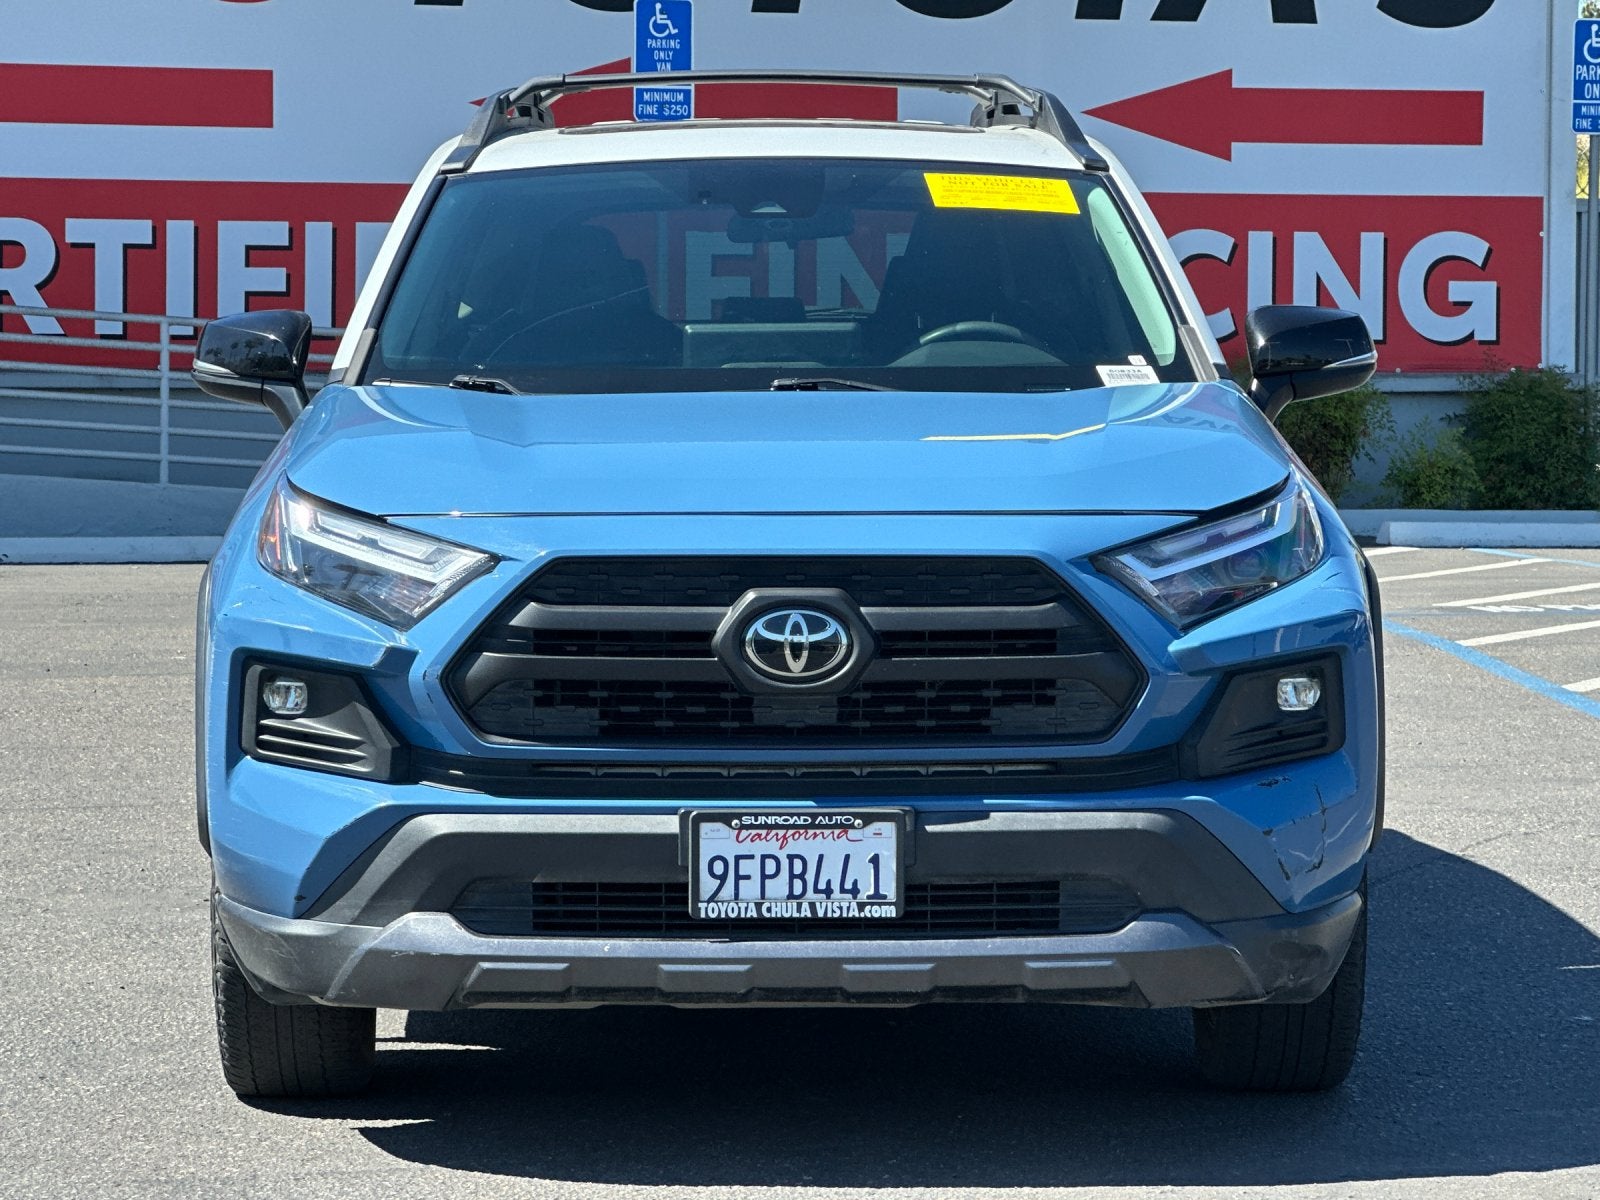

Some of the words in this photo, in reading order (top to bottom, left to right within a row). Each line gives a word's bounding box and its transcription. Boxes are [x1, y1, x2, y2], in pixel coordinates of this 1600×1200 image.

[647, 38, 681, 49] PARKING
[653, 50, 673, 60] ONLY
[656, 61, 671, 72] VAN
[643, 91, 684, 103] MINIMUM
[638, 104, 658, 115] FINE
[662, 104, 688, 116] $250
[1581, 105, 1600, 116] MINI
[1575, 118, 1592, 129] FINE
[0, 216, 393, 338] RTIFI
[741, 815, 811, 825] SUNROAD
[815, 815, 854, 825] AUTO
[735, 828, 863, 850] California
[707, 853, 887, 901] 9FPB441
[699, 903, 757, 918] TOYOTA
[761, 903, 812, 918] CHULA
[815, 903, 896, 918] VISTA.com
